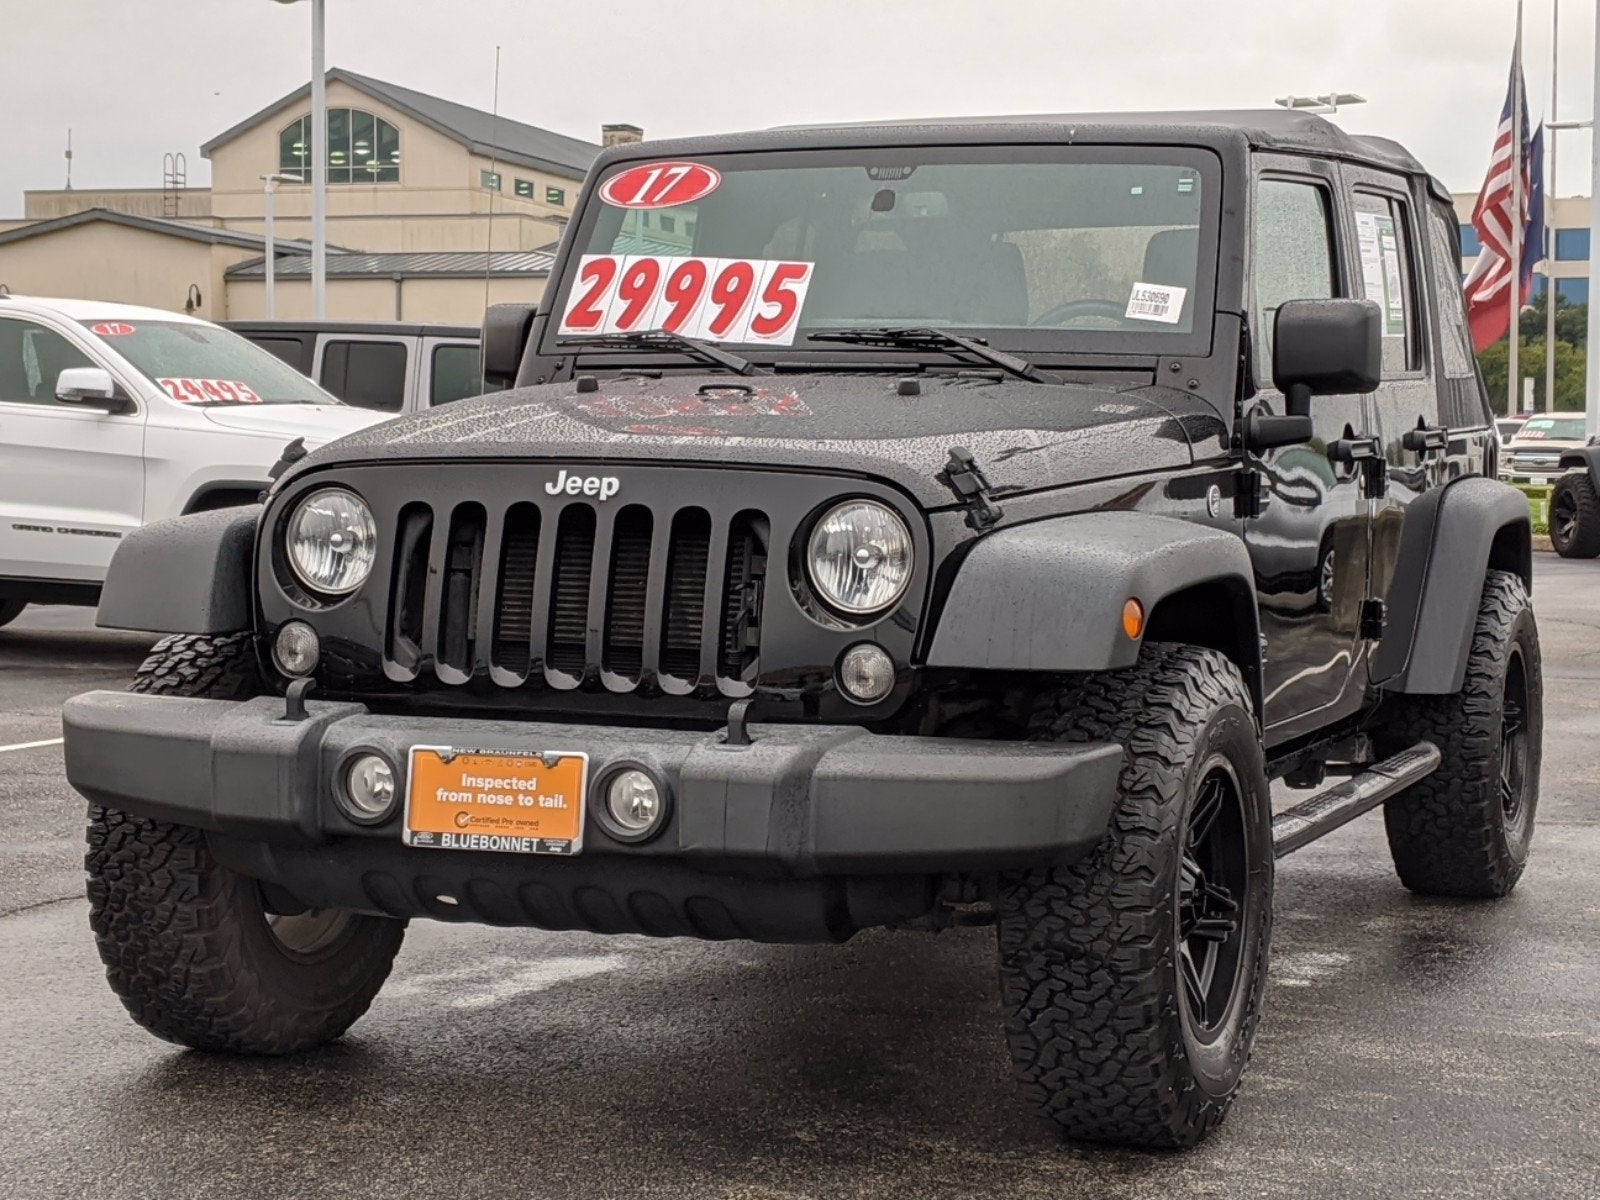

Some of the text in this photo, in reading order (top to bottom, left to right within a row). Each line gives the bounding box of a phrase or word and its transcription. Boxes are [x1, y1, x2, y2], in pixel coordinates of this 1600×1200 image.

[625, 166, 693, 205] 17
[564, 257, 809, 338] 29995
[104, 323, 120, 335] 17
[544, 470, 620, 500] Jeep
[12, 524, 122, 539] GRAND CHEROKEE
[461, 773, 537, 791] Inspected
[436, 789, 568, 809] from nose to tail.
[469, 816, 500, 825] Certified
[441, 833, 540, 852] BLUEBONNET
